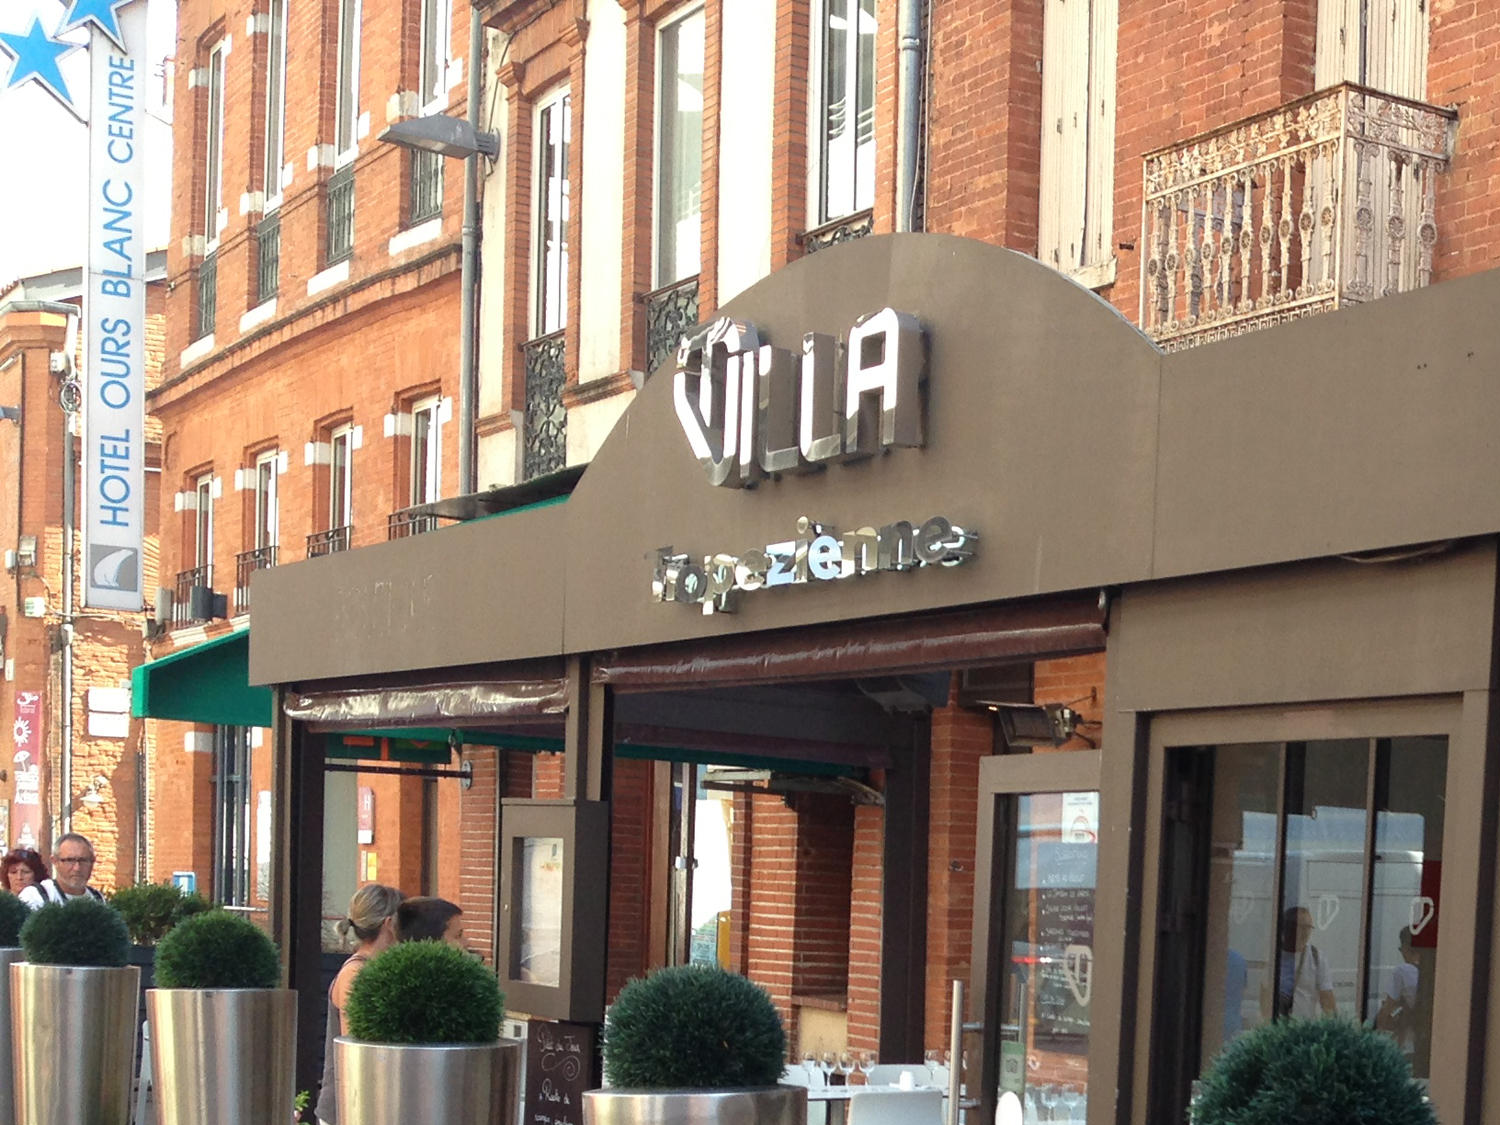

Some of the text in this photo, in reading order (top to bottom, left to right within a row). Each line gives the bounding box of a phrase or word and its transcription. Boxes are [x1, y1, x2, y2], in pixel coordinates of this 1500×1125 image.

[100, 56, 134, 527] HOTEL OURS BLANC CENTRE
